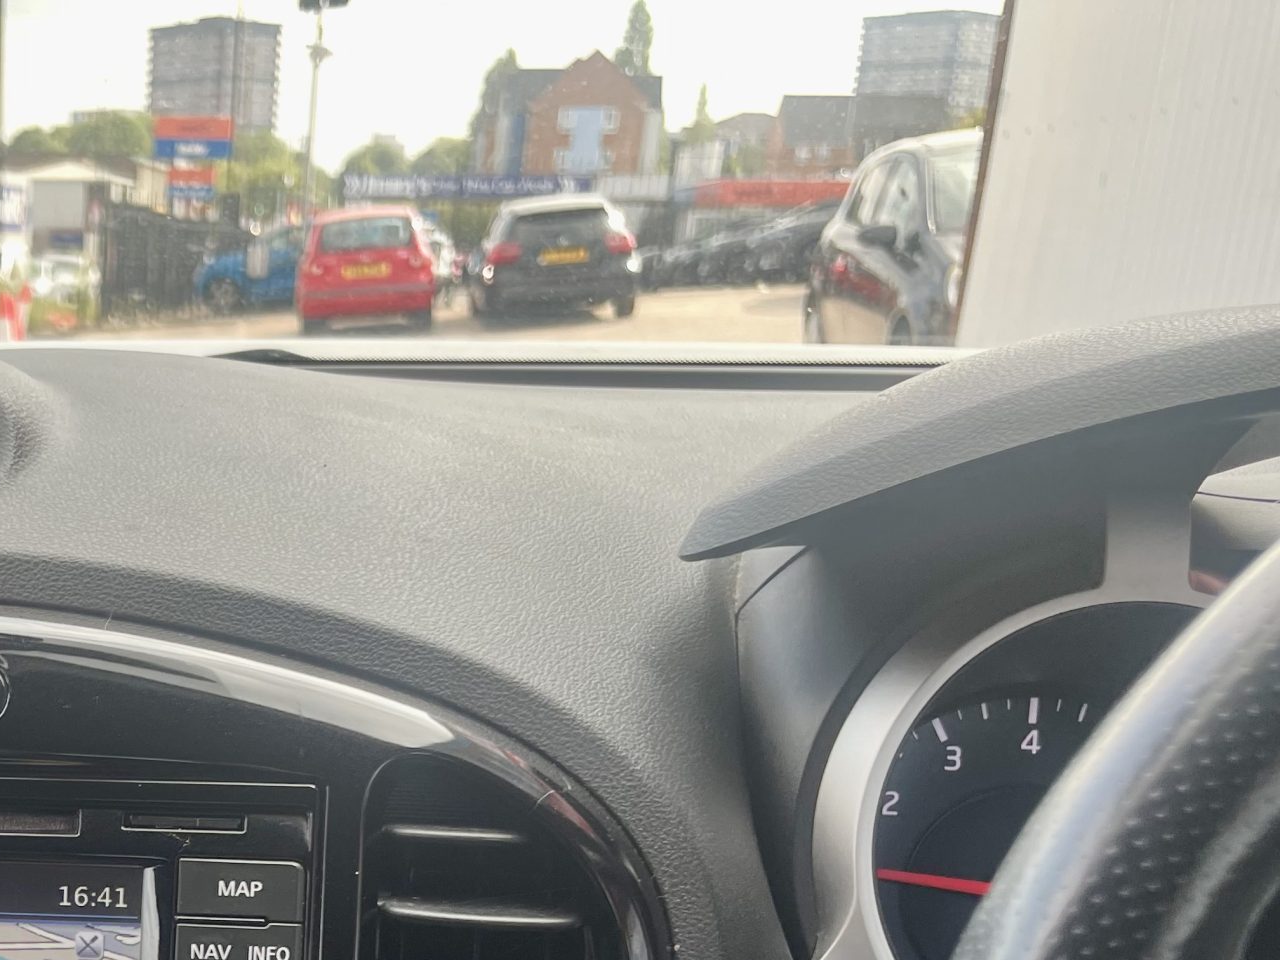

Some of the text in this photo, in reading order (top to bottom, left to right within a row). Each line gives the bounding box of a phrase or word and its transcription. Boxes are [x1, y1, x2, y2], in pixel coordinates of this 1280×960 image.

[1020, 730, 1041, 755] 4
[944, 745, 962, 772] 3
[881, 791, 899, 816] 2
[59, 886, 128, 908] 16:41
[218, 881, 264, 898] MAP
[190, 944, 231, 960] NAV
